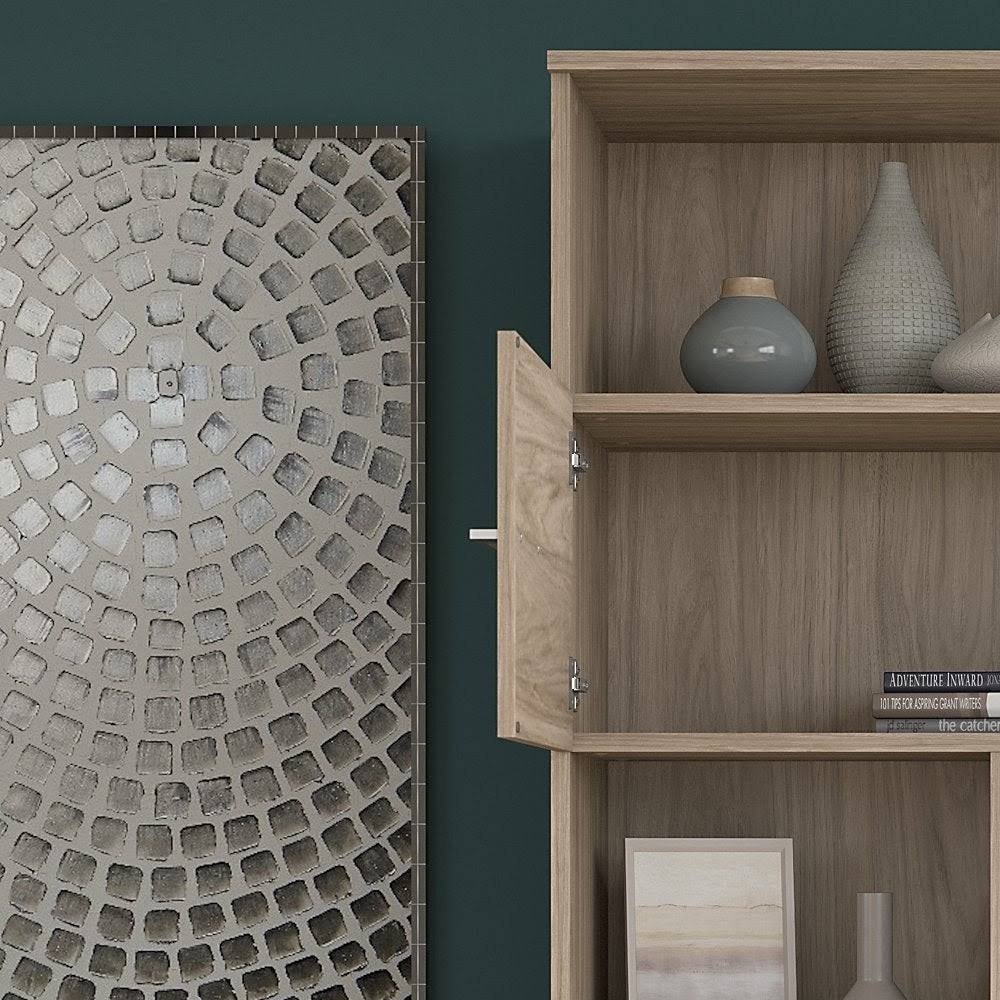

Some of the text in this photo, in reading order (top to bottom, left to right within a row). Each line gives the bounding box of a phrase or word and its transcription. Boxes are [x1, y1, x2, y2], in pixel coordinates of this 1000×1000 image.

[889, 672, 944, 687] ADVENTURE
[946, 672, 984, 687] INWARD
[880, 697, 982, 710] 101 TIPS FOR ASPIRING GRANT WRITERS
[939, 719, 957, 732] the
[959, 719, 1000, 732] catcher
